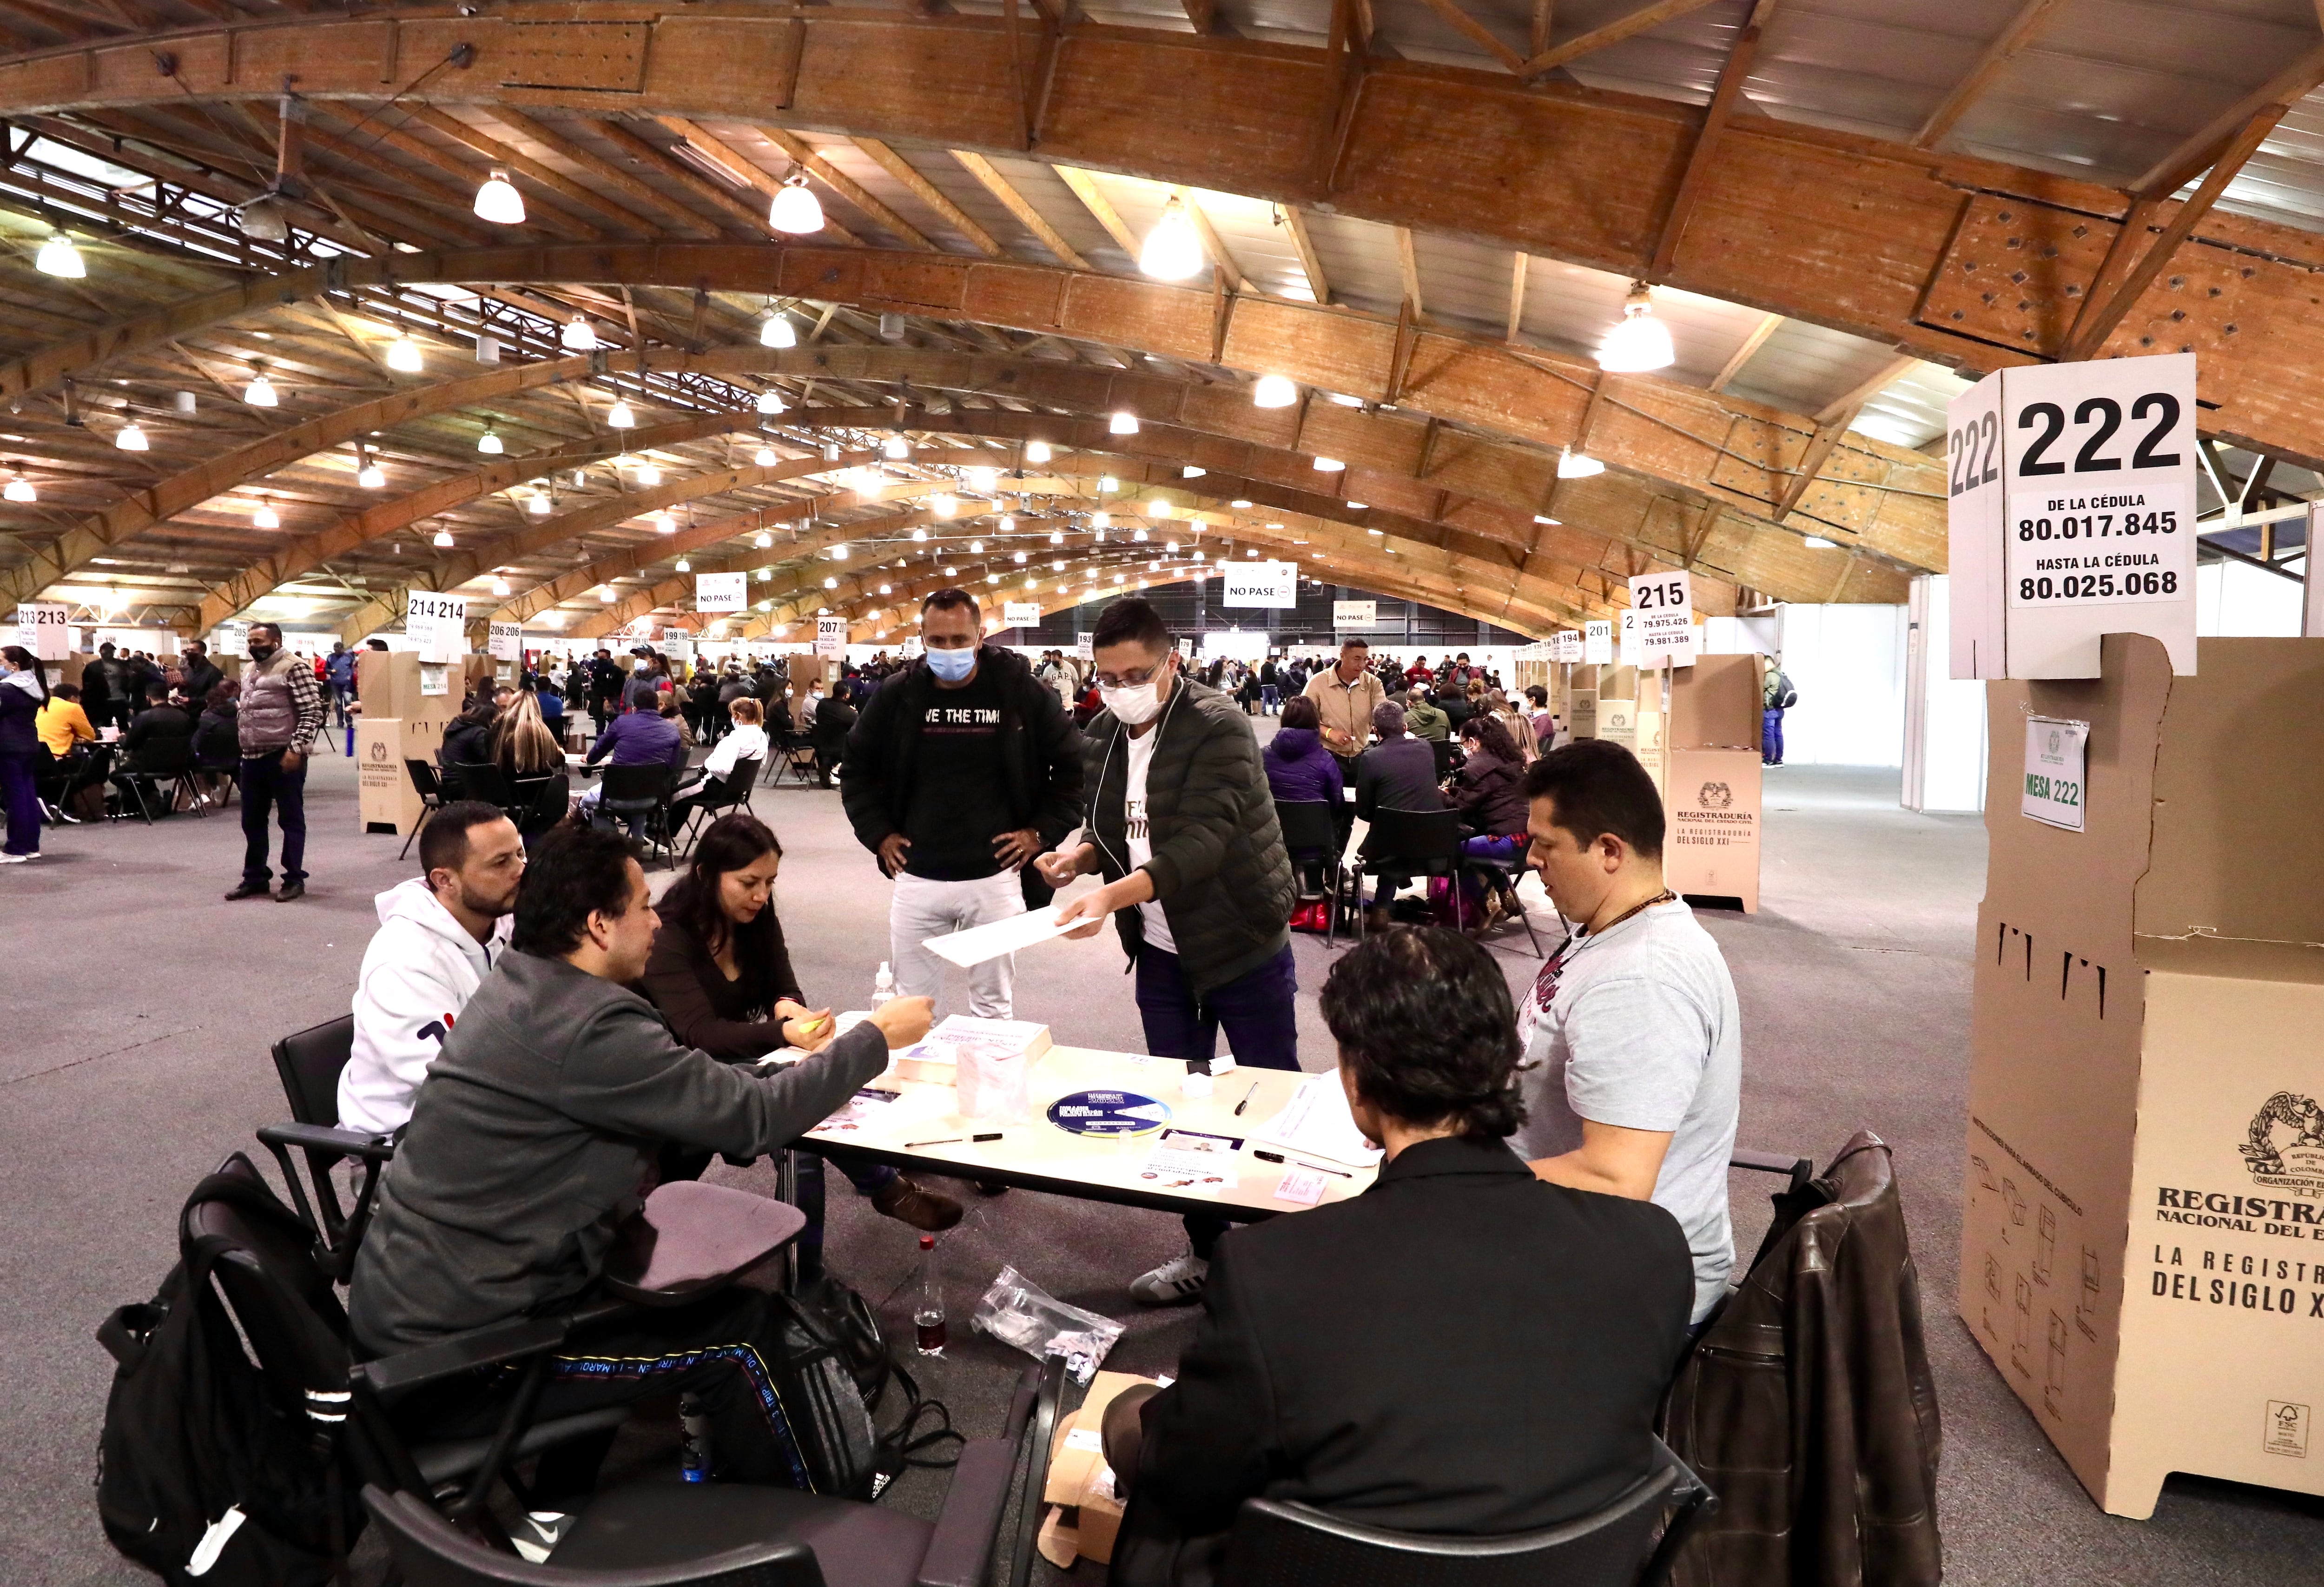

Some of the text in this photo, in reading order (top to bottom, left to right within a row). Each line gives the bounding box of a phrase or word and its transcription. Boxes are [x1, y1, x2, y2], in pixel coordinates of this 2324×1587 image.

[2018, 392, 2181, 477] 222
[1951, 410, 1998, 497] 222
[2048, 494, 2146, 511] DE LA CÉDULA
[2019, 511, 2177, 542] 80.017.845
[2037, 553, 2159, 570] HASTA LA CÉDULA
[2020, 571, 2177, 600] 80.025.068
[1638, 582, 1684, 609] 215
[410, 599, 434, 616] 214
[439, 602, 463, 619] 214
[20, 610, 35, 624] 213
[38, 611, 65, 624] 213
[1644, 618, 1688, 628] 79.975.426
[234, 628, 246, 637] 205
[490, 625, 504, 635] 206
[506, 627, 519, 636] 206
[820, 622, 837, 632] 207
[1590, 626, 1608, 636] 201
[1645, 636, 1689, 645] 79.981.389
[1052, 672, 1069, 681] GAP
[945, 709, 971, 723] THE
[2026, 773, 2078, 806] MESA 222
[1677, 811, 1753, 820] REGISTRADURÍA
[2257, 1176, 2314, 1187] ORGANIZACIÓN
[2157, 1210, 2257, 1232] NACIONAL
[2265, 1223, 2305, 1238] DEL
[2155, 1245, 2324, 1285] LA REGISTR
[2152, 1271, 2201, 1301] DEL
[2210, 1279, 2295, 1314] SIGLO
[872, 1475, 890, 1498] adidas
